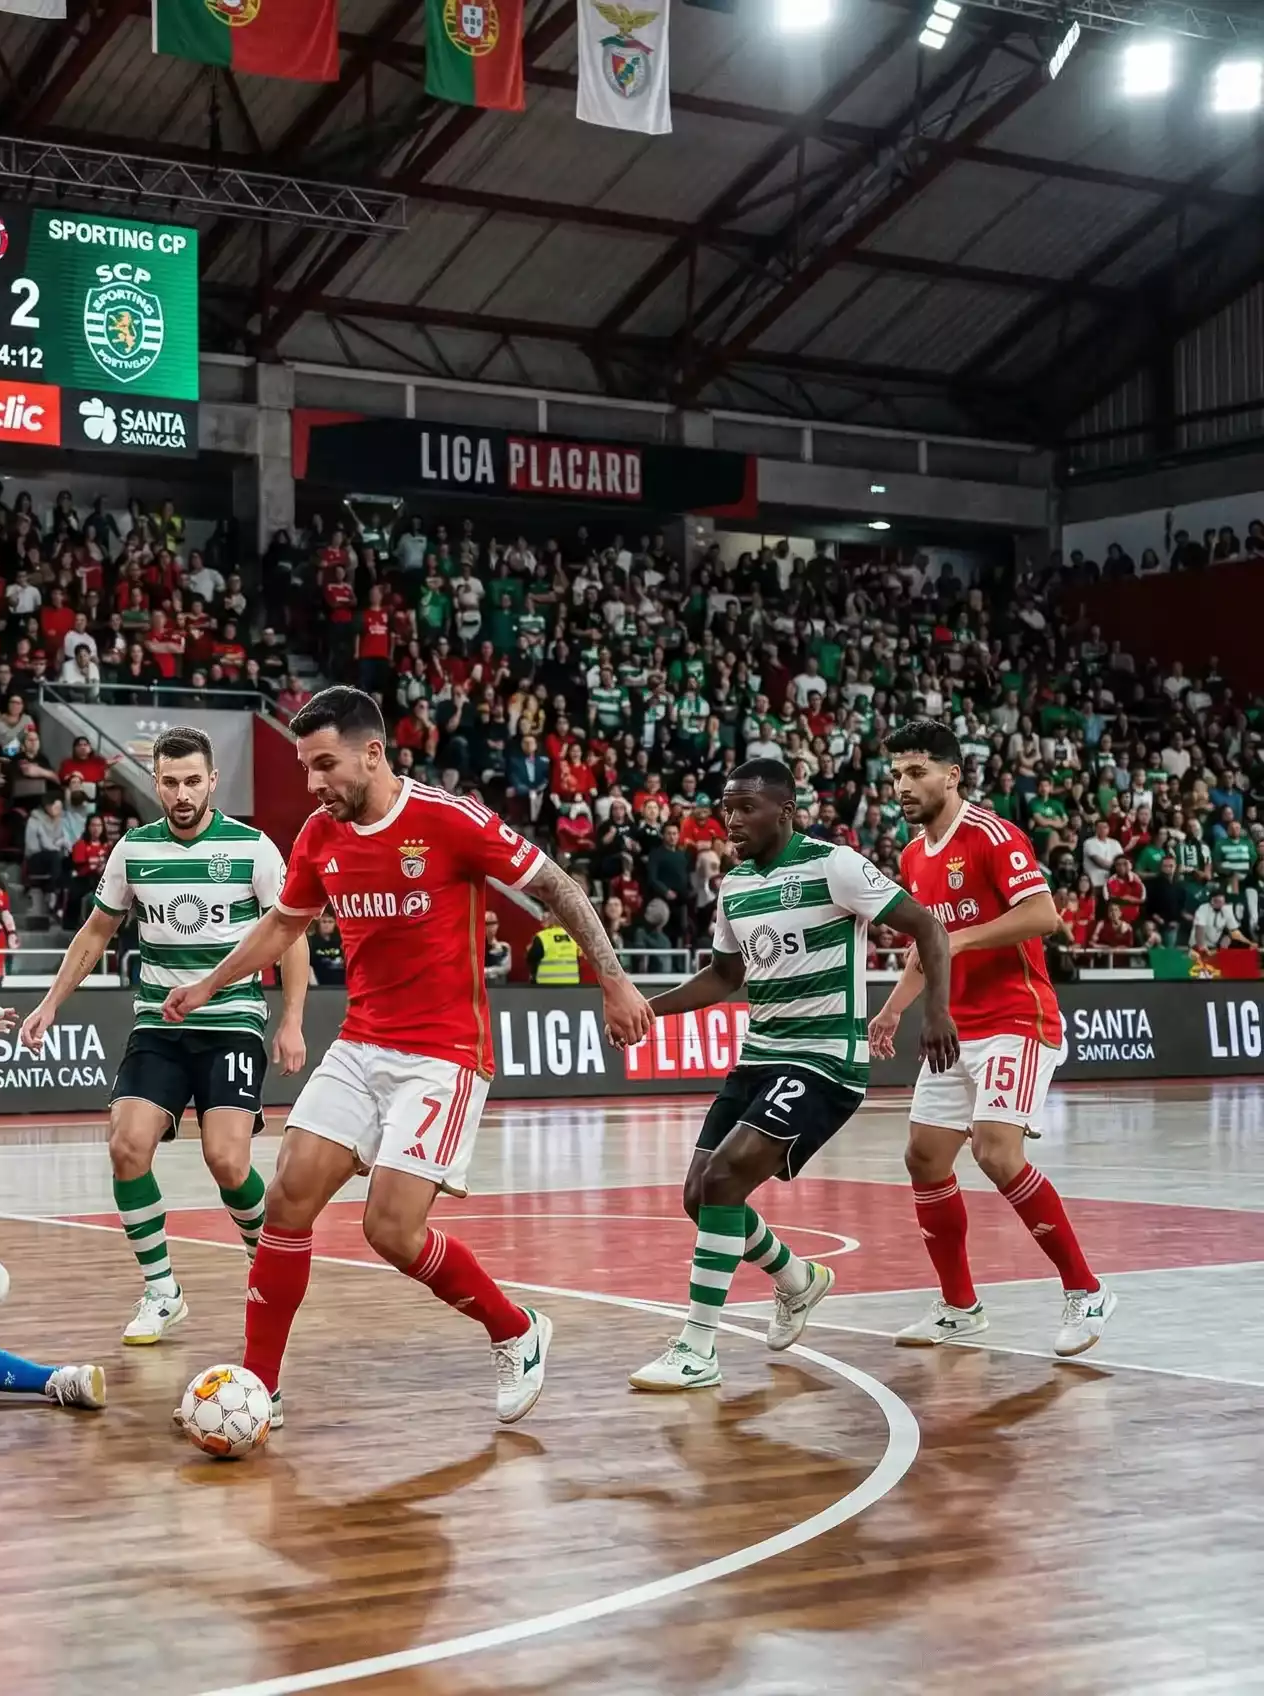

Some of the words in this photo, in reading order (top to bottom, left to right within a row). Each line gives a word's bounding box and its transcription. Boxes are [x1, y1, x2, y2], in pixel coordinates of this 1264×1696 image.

[48, 219, 154, 252] SPORTING
[158, 232, 187, 254] CP
[96, 263, 151, 284] SCP
[10, 277, 40, 329] 2
[121, 410, 186, 436] SANTA
[420, 432, 495, 484] LIGA
[508, 442, 642, 494] PLACARD
[1073, 1008, 1153, 1040] SANTA
[500, 1009, 606, 1076] LIGA
[1077, 1044, 1120, 1061] SANTA
[1121, 1043, 1156, 1060] CASA
[57, 1066, 108, 1087] CASA
[224, 1051, 254, 1087] 14
[984, 1056, 1017, 1091] 15
[764, 1076, 806, 1113] 12
[414, 1096, 442, 1139] 7
